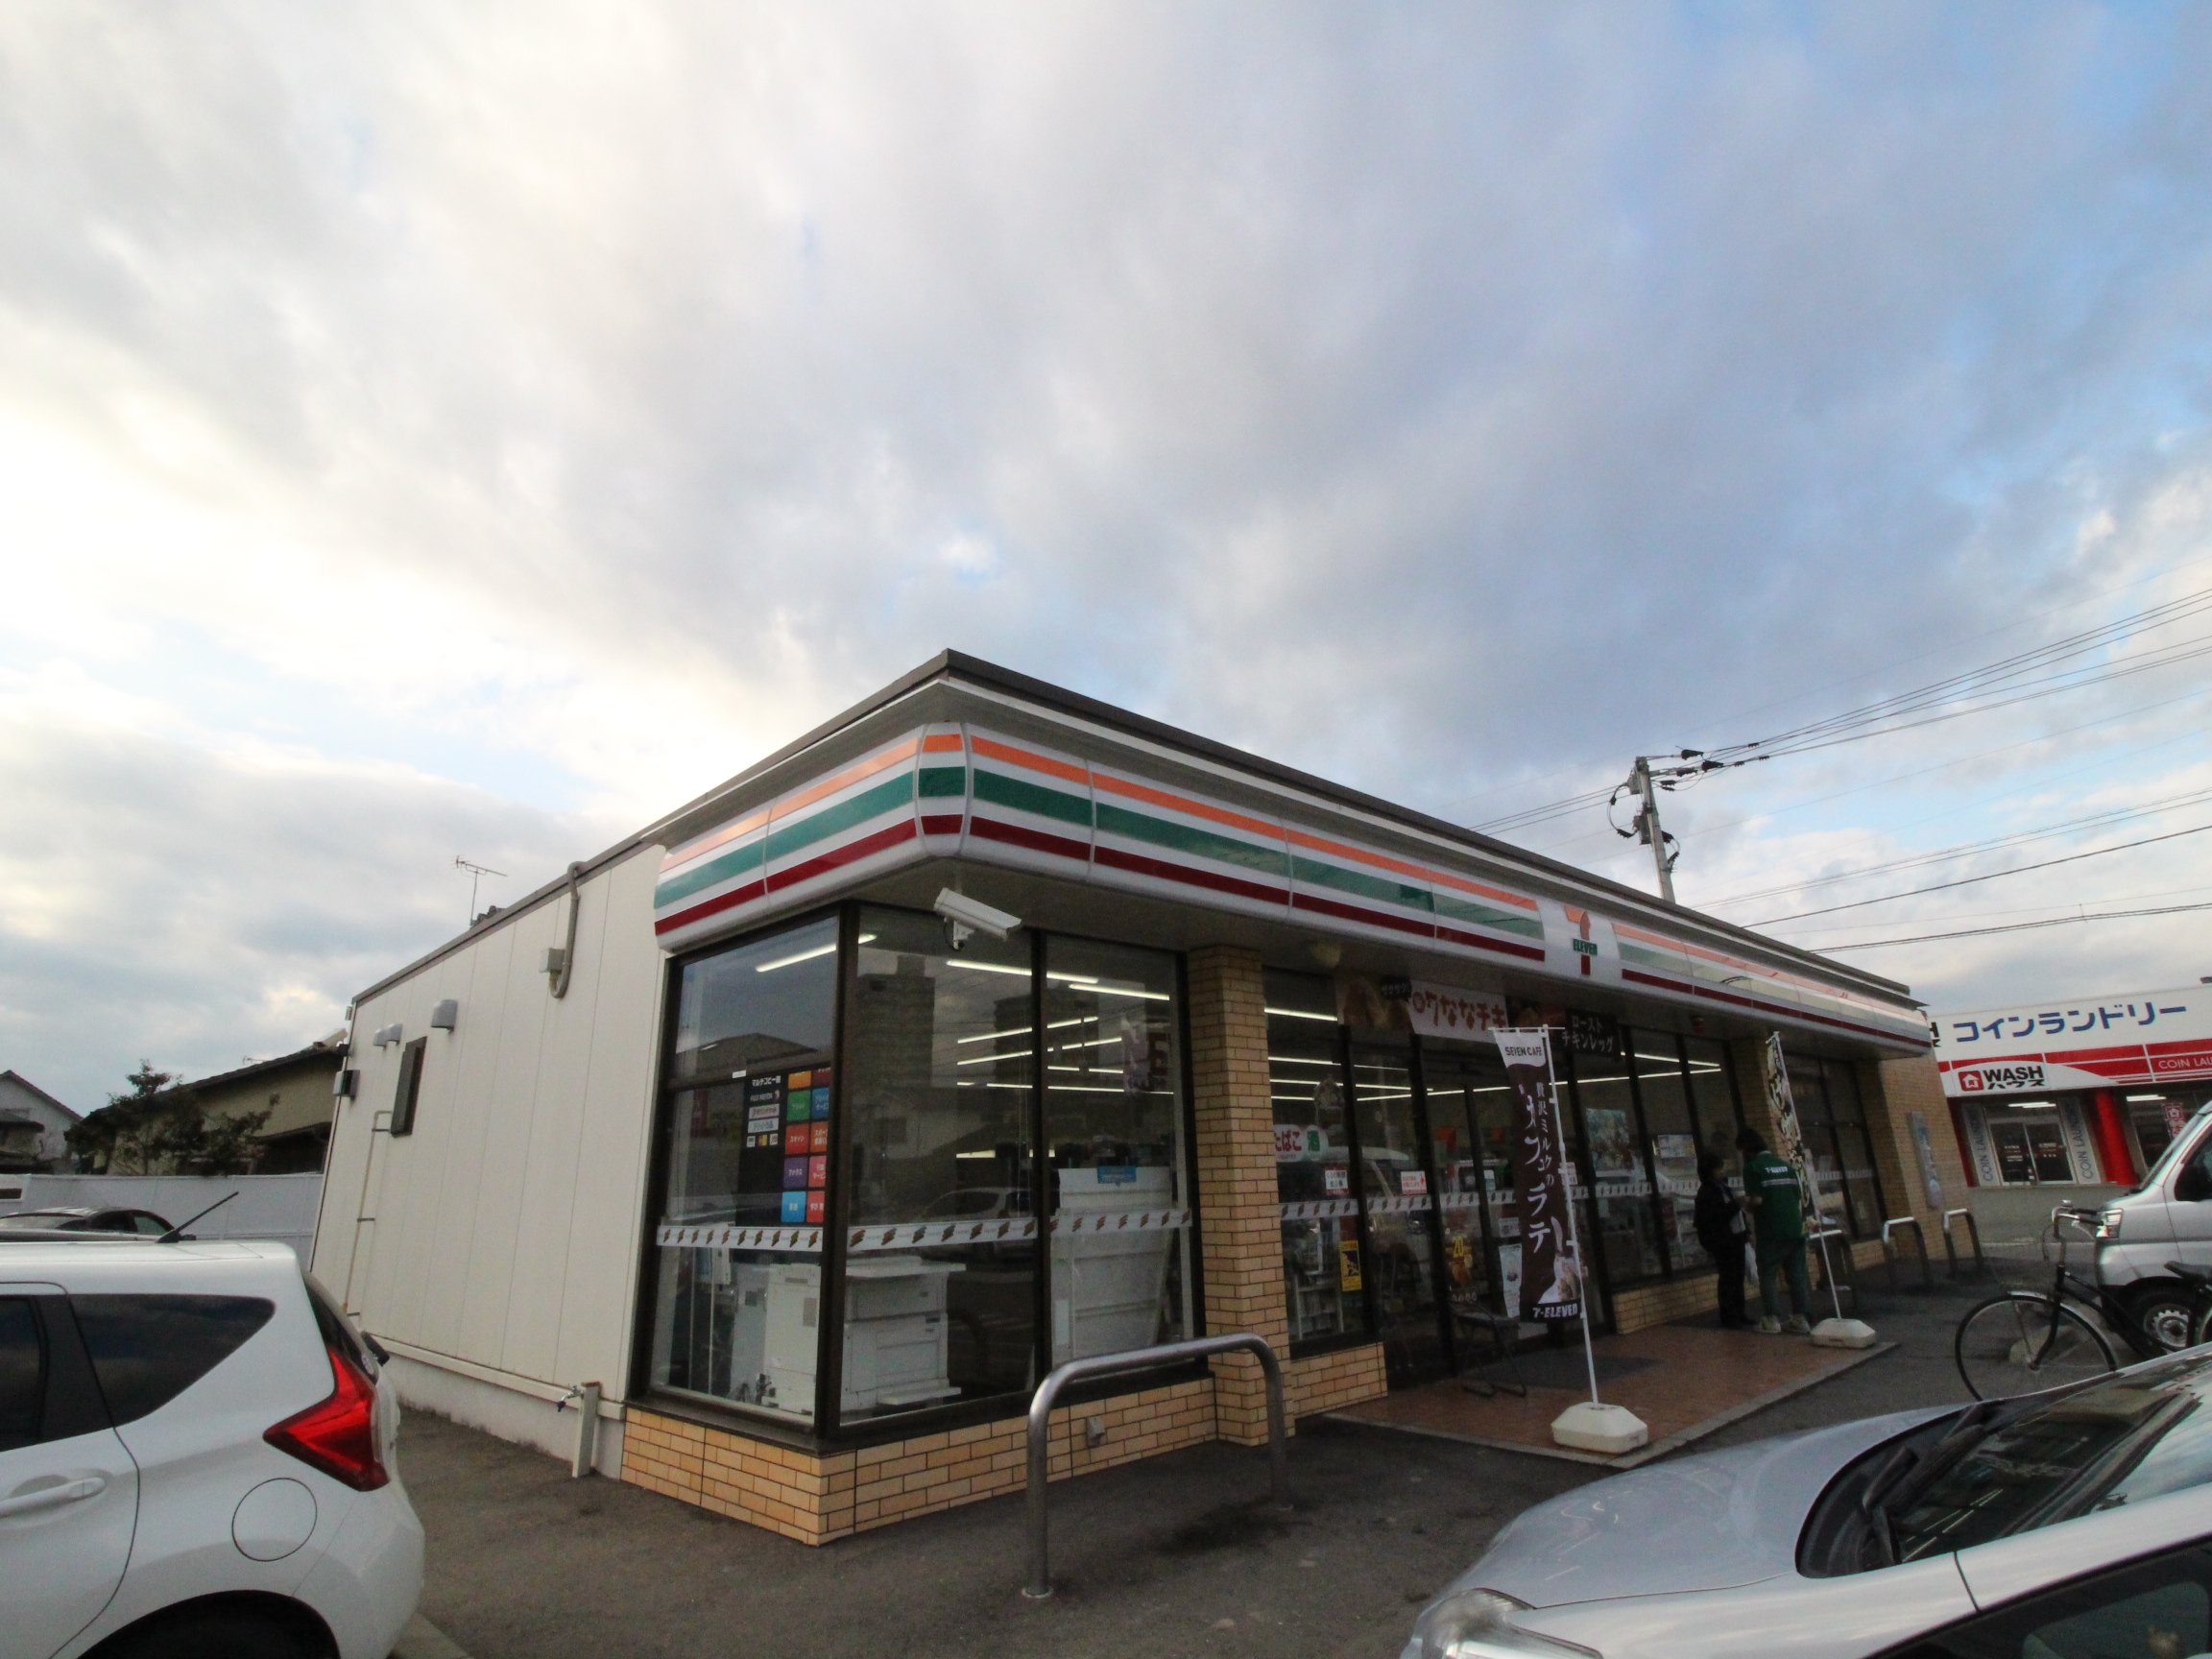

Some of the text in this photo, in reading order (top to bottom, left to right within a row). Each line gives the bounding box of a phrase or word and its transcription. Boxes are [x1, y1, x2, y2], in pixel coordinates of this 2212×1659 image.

[1573, 938, 1599, 956] ELEVEN
[1953, 1001, 2187, 1043] コインランドリー
[1504, 1046, 1527, 1056] SEVEN
[2157, 1058, 2191, 1071] COIN
[1983, 1065, 2044, 1083] WASH
[1532, 1303, 1578, 1319] 7-ELEVEN
